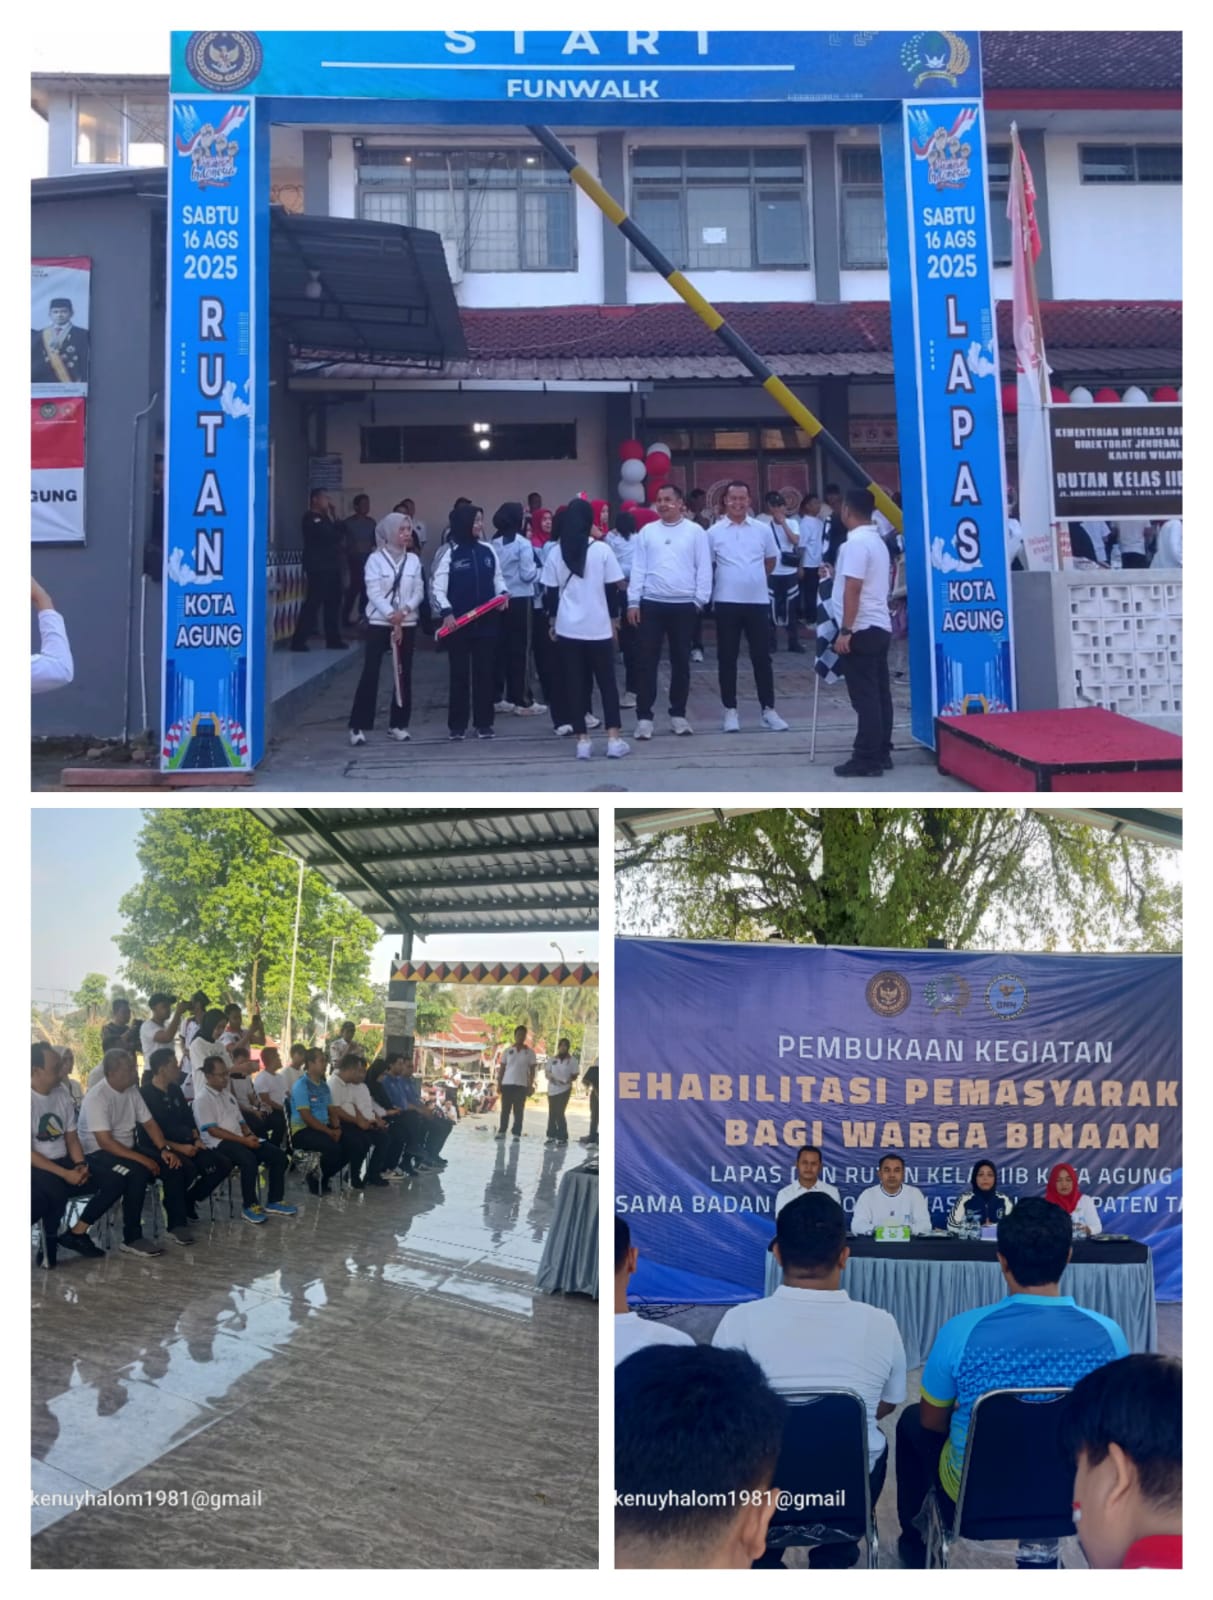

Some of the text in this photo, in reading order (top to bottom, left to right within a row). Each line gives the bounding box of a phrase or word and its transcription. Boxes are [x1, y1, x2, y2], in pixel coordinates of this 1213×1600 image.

[507, 79, 659, 98] FUNWALK
[182, 205, 239, 225] SABTU
[923, 206, 976, 226] SABTU
[183, 230, 239, 249] 16 AGS
[925, 230, 977, 249] 16 AGS
[184, 255, 238, 279] 2025
[927, 254, 978, 279] 2025
[195, 297, 226, 574] RUTAN
[946, 296, 980, 562] LAPAS
[1055, 427, 1119, 437] KEMENTERIAN
[1075, 439, 1133, 449] DIREKTORAT
[1057, 471, 1108, 488] RUTAN
[1113, 471, 1161, 487] KELAS
[31, 489, 77, 502] GUNG
[949, 580, 997, 601] KOTA
[185, 594, 235, 616] KOTA
[943, 609, 1004, 631] AGUNG
[175, 624, 242, 647] AGUNG
[778, 1035, 1113, 1063] PEMBUKAAN KEGIATAN
[618, 1072, 1179, 1107] EHABILITASI PEMASYARAK
[725, 1119, 1160, 1149] BAGI WARGA BINAAN
[711, 1165, 782, 1183] LAPAS
[845, 1166, 918, 1184] RUN
[1001, 1167, 1028, 1184] IIB
[1098, 1167, 1172, 1184] AGUNG
[615, 1195, 683, 1213] SAMA
[692, 1195, 770, 1213] BADAN
